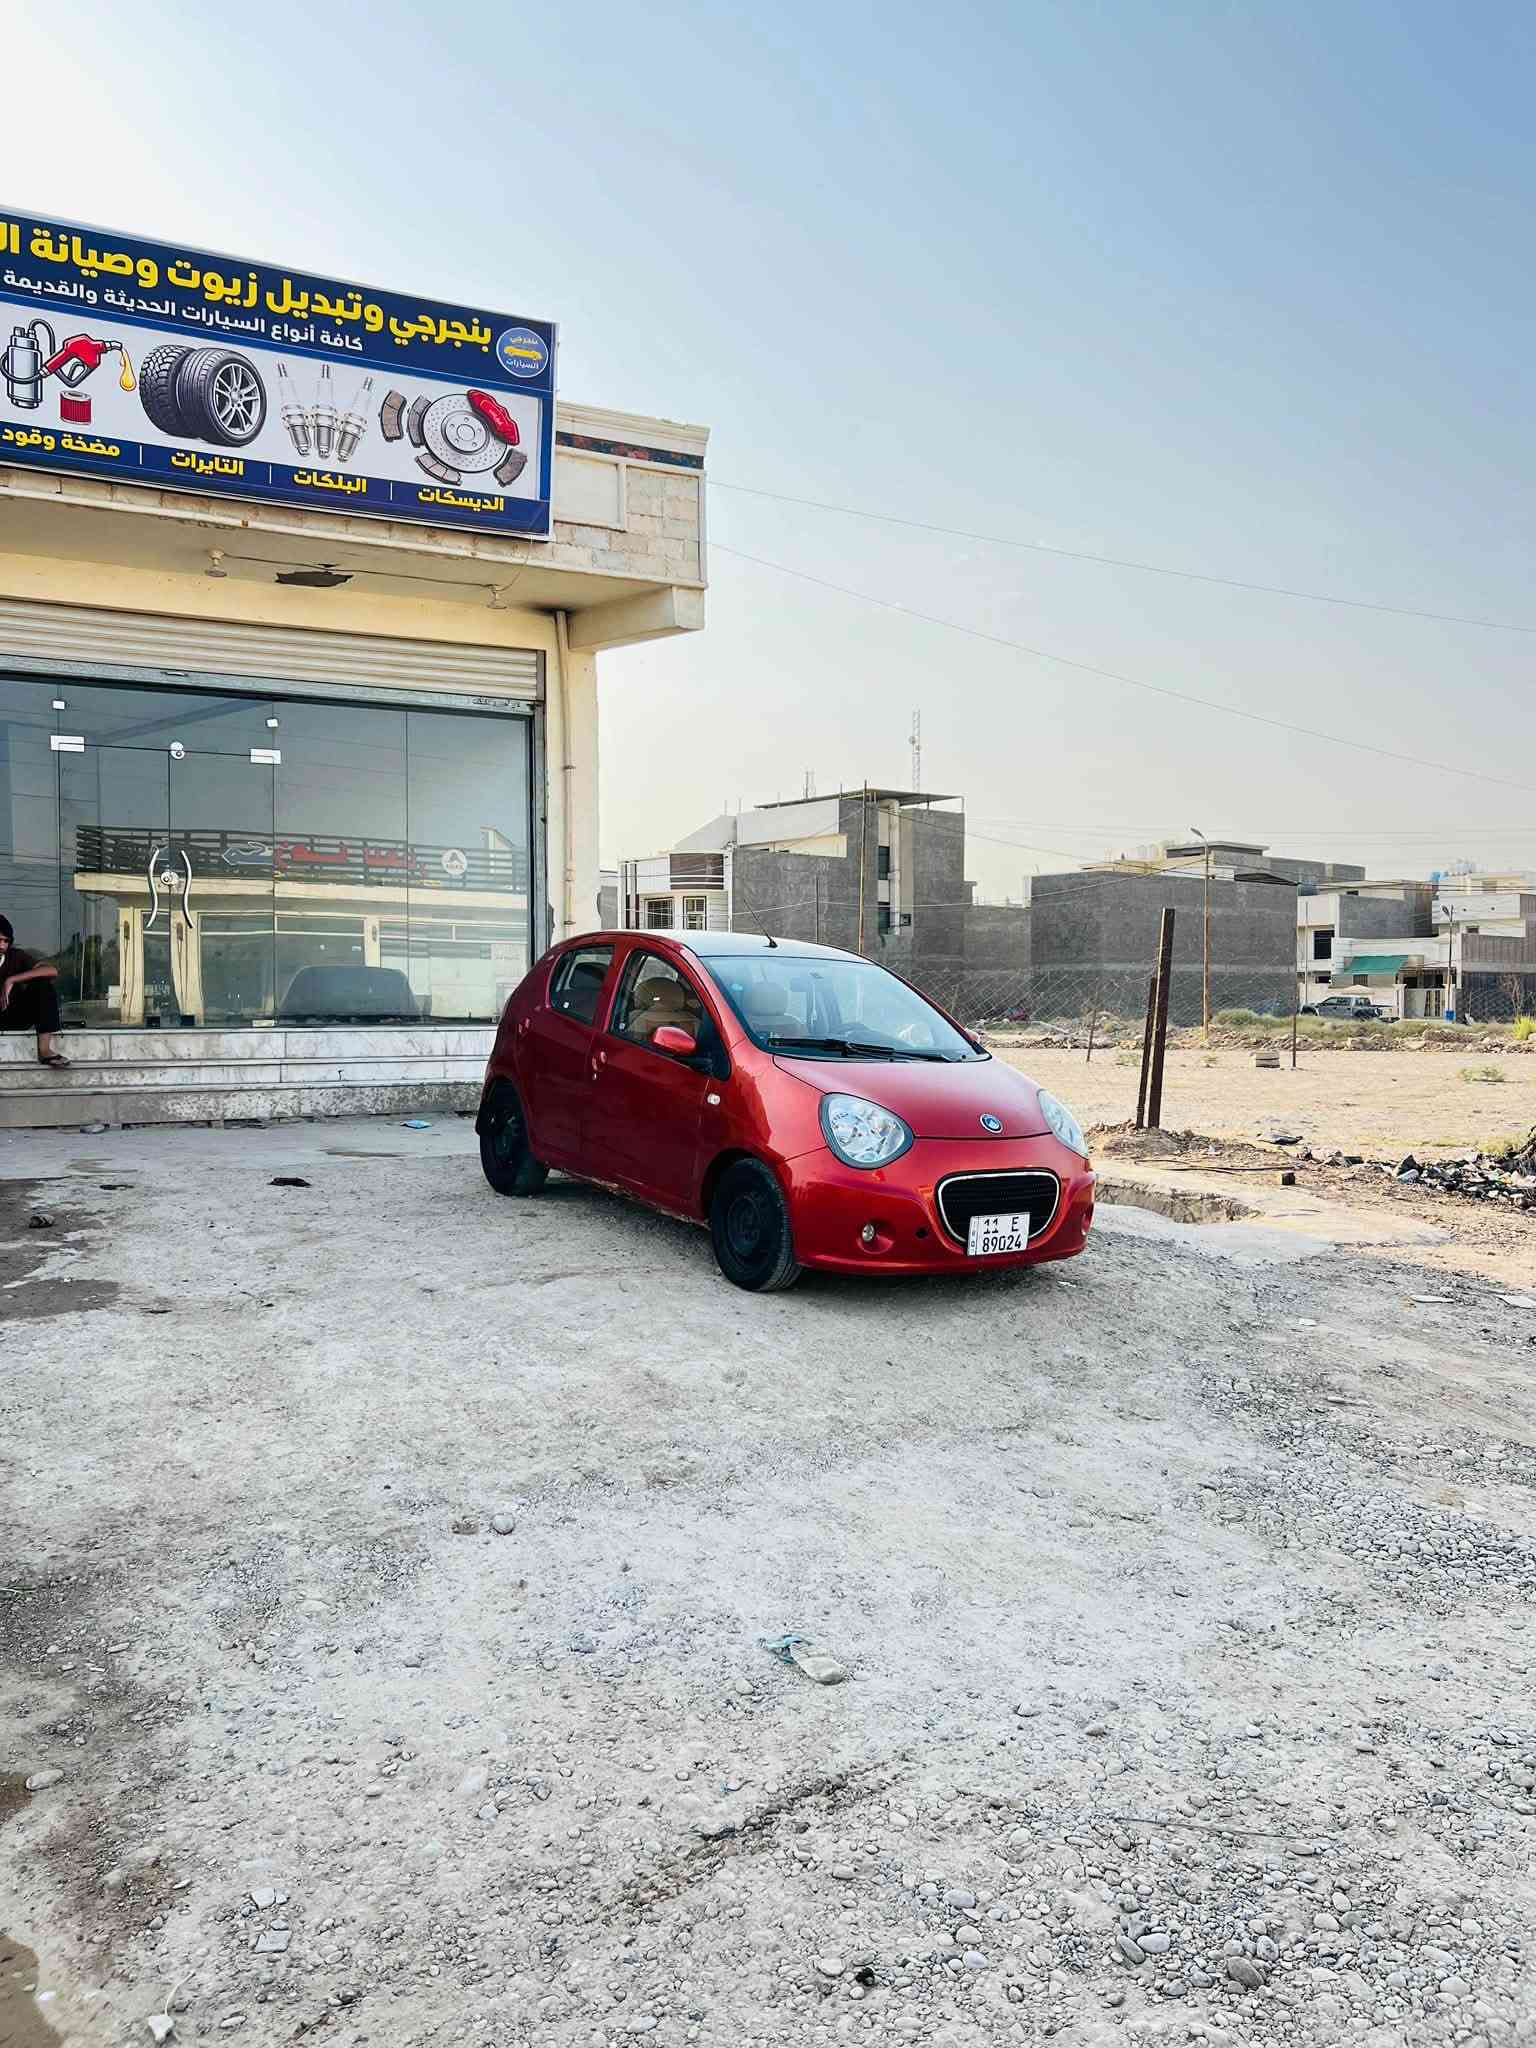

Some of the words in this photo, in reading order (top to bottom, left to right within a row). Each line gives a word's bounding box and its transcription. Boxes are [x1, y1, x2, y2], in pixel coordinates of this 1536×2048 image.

[30, 228, 159, 288] وصيانة
[3, 270, 98, 304] والقديمة
[167, 260, 258, 307] زيوت
[104, 288, 176, 317] الحديثة
[266, 279, 384, 332] وتبديل
[182, 305, 265, 333] السيارات
[271, 323, 315, 342] أنواع
[320, 330, 364, 351] كافة
[389, 314, 492, 352] بنجرجي
[2, 427, 56, 450] وقود
[61, 433, 120, 457] مضخة
[170, 450, 244, 476] التايرات
[293, 470, 367, 494] البلكات
[418, 487, 505, 512] الديسكات
[984, 1218, 999, 1234] 11
[1011, 1216, 1020, 1232] E
[983, 1234, 1022, 1252] 89024
